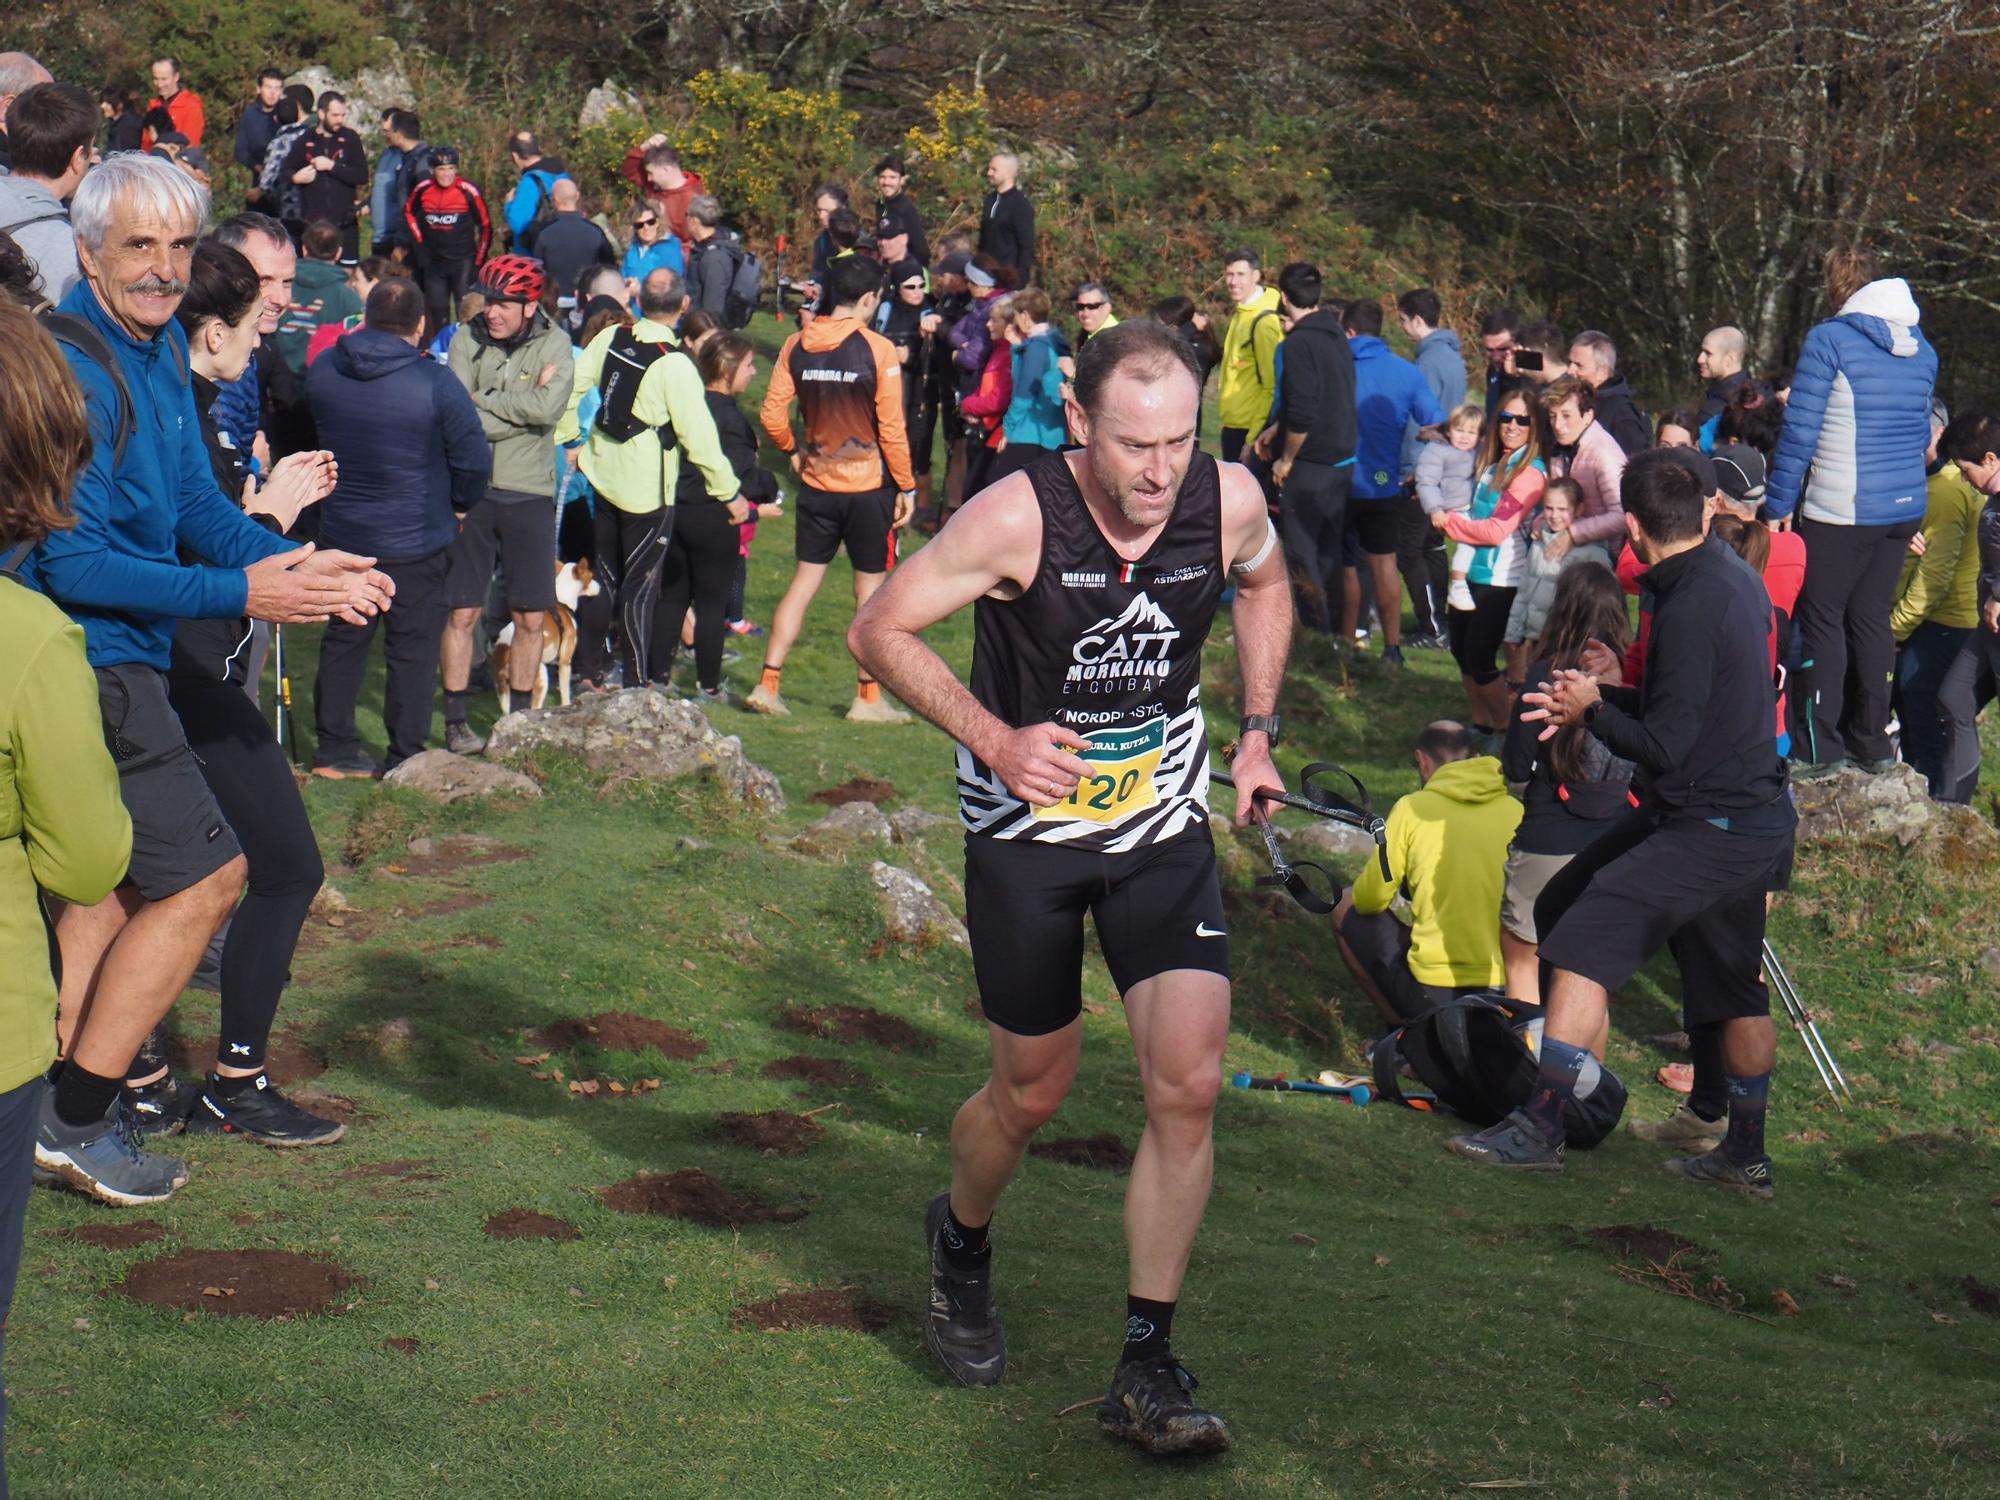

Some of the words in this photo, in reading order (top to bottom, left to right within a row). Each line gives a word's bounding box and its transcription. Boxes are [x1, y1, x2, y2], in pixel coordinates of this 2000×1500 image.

[1061, 572, 1106, 583] MORKAIKO
[1153, 568, 1208, 584] ASTIGARRAGA
[1174, 566, 1192, 575] CASA
[1072, 630, 1181, 665] CATT
[1066, 660, 1170, 681] MORKAIKO
[1119, 735, 1151, 751] KUTXA
